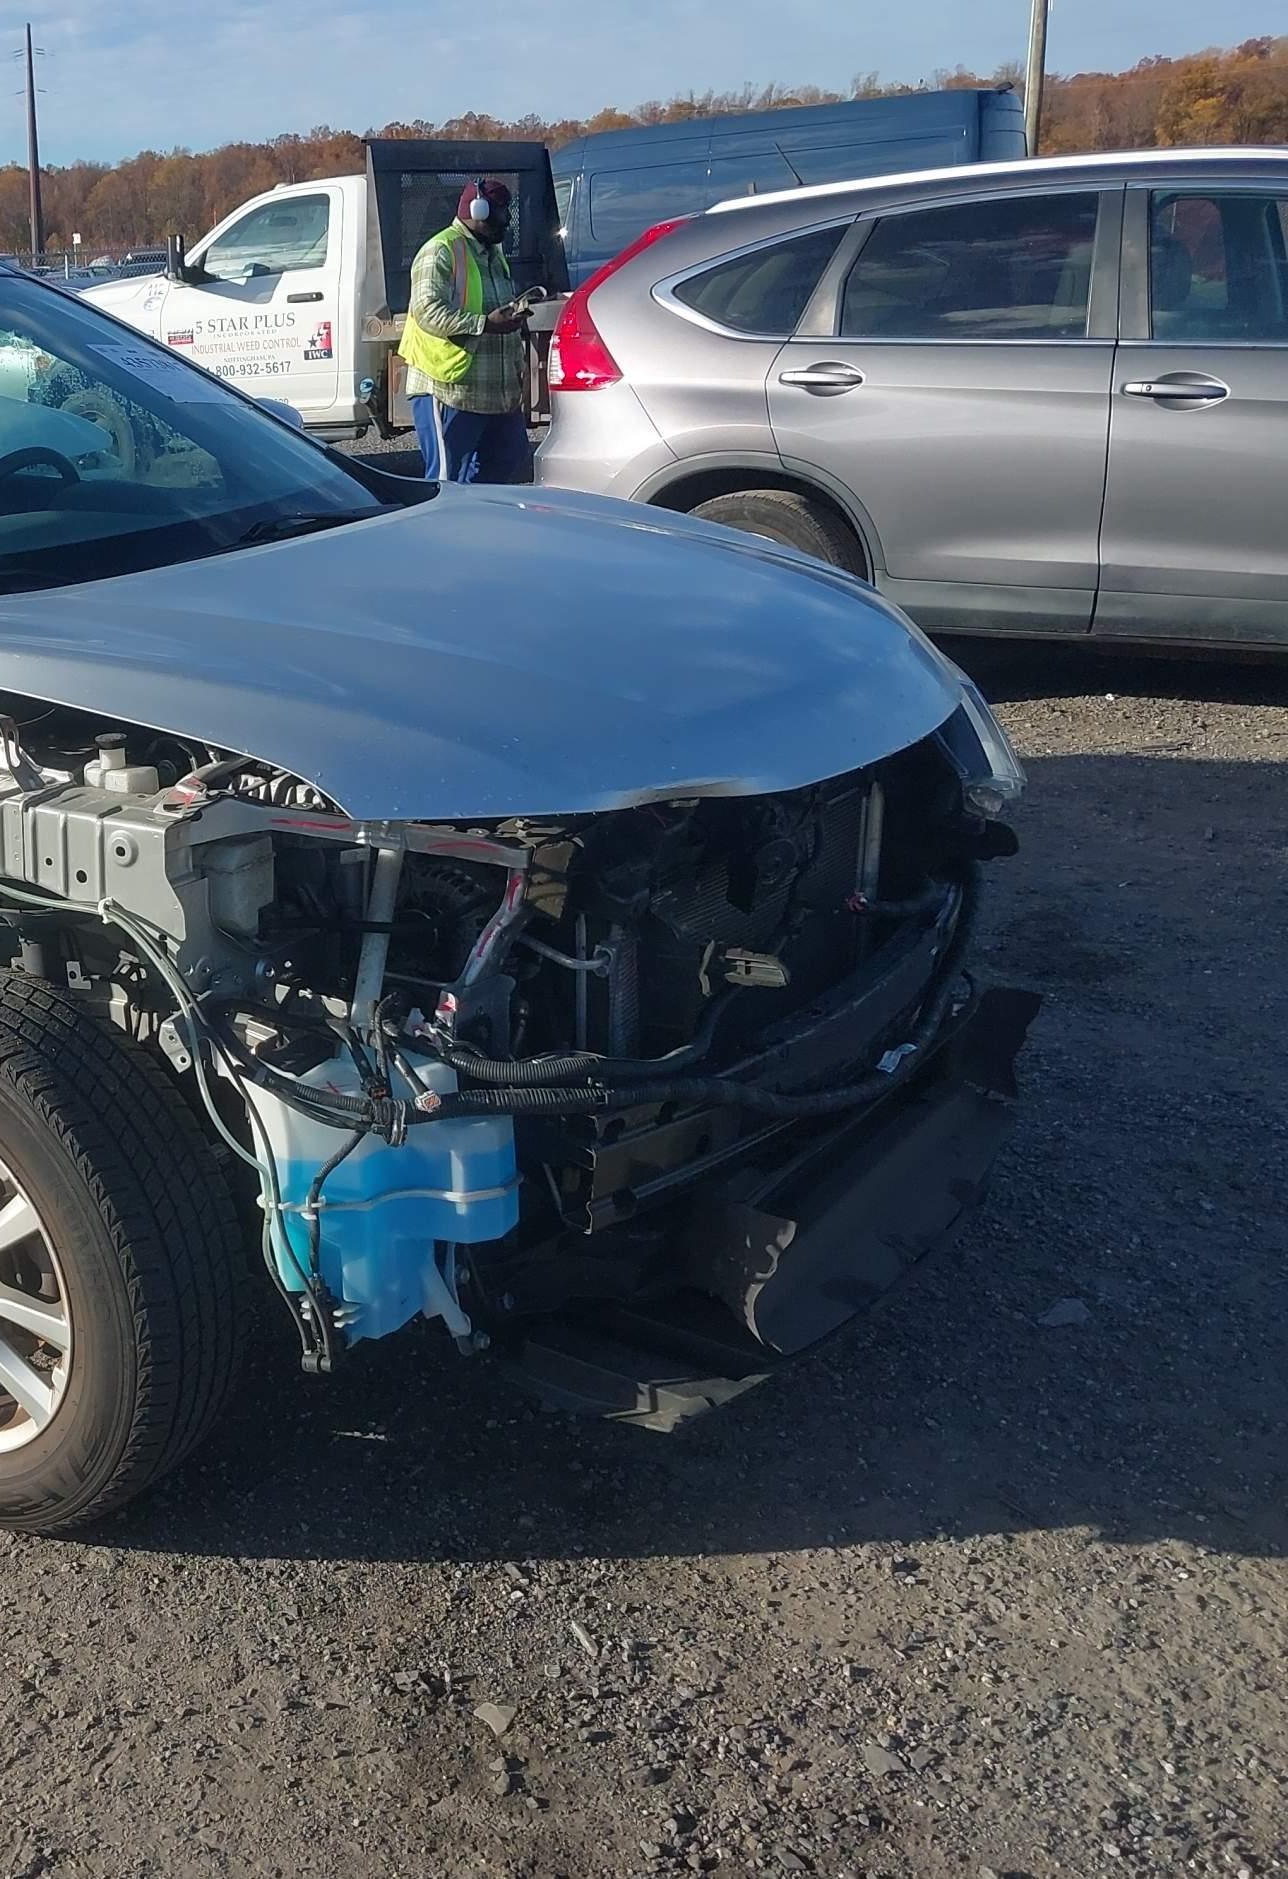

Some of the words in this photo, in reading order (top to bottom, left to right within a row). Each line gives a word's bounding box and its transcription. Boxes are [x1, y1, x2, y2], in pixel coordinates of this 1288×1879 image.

[195, 321, 203, 335] 5
[207, 317, 249, 334] STAR
[254, 312, 296, 329] PLUS
[212, 329, 278, 339] INCORPORATED
[192, 341, 236, 355] INDUSTRIAL
[237, 340, 261, 353] WEED
[262, 336, 302, 350] CONTROL
[308, 350, 329, 360] IWC
